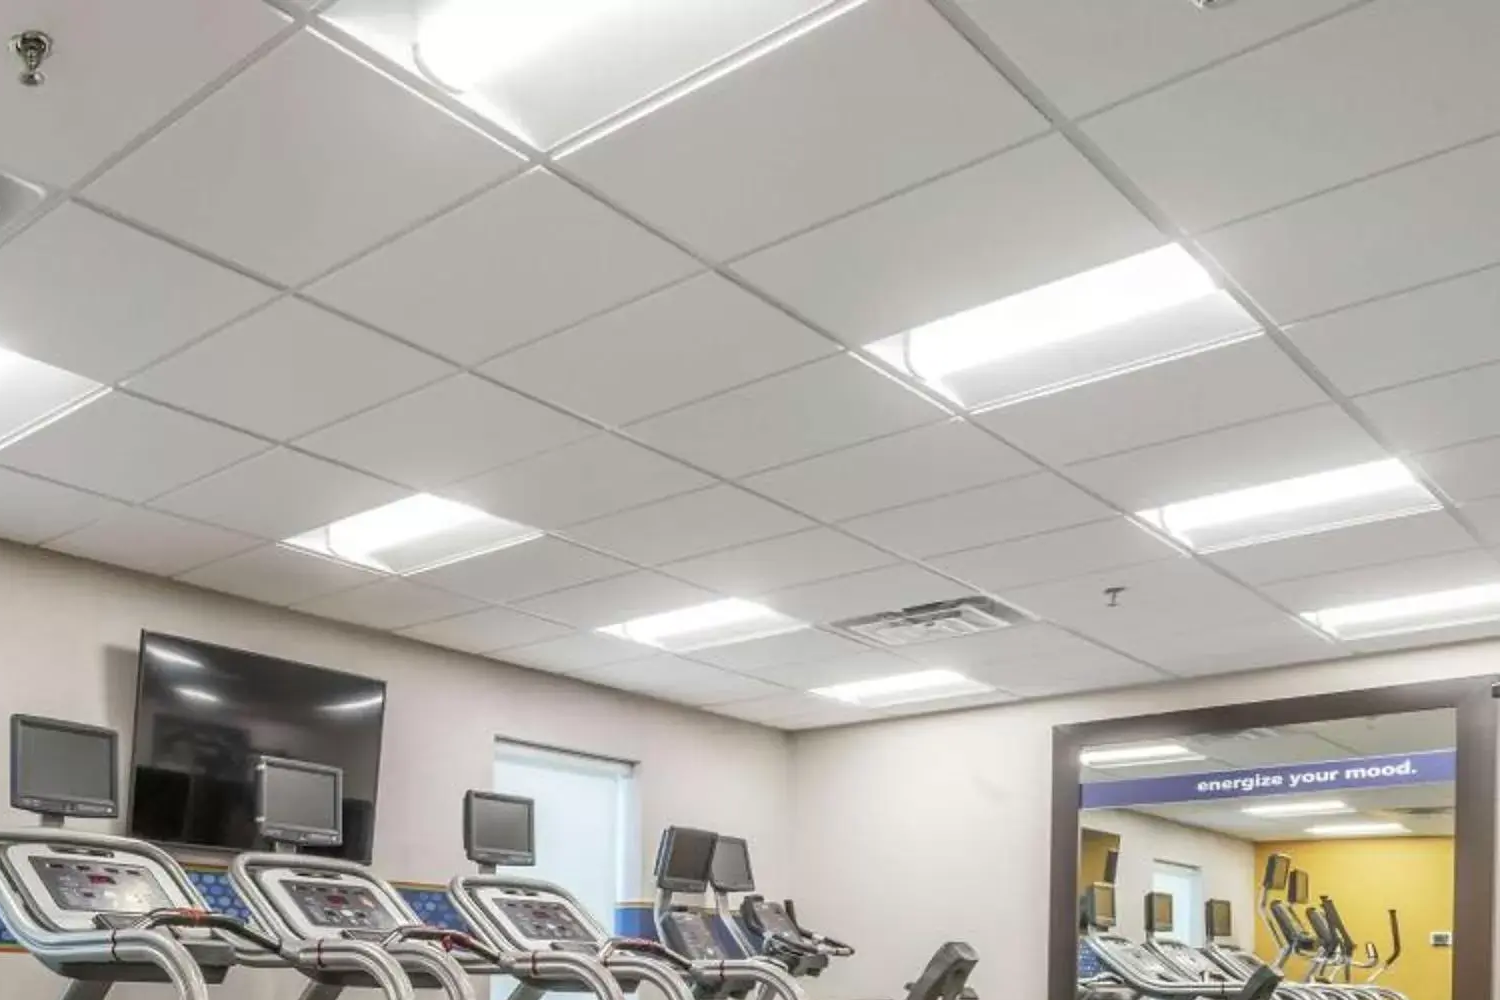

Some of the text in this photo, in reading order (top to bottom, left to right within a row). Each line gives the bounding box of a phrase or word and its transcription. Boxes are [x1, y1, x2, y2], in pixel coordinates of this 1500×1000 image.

[1196, 759, 1419, 792] energize your mood.
